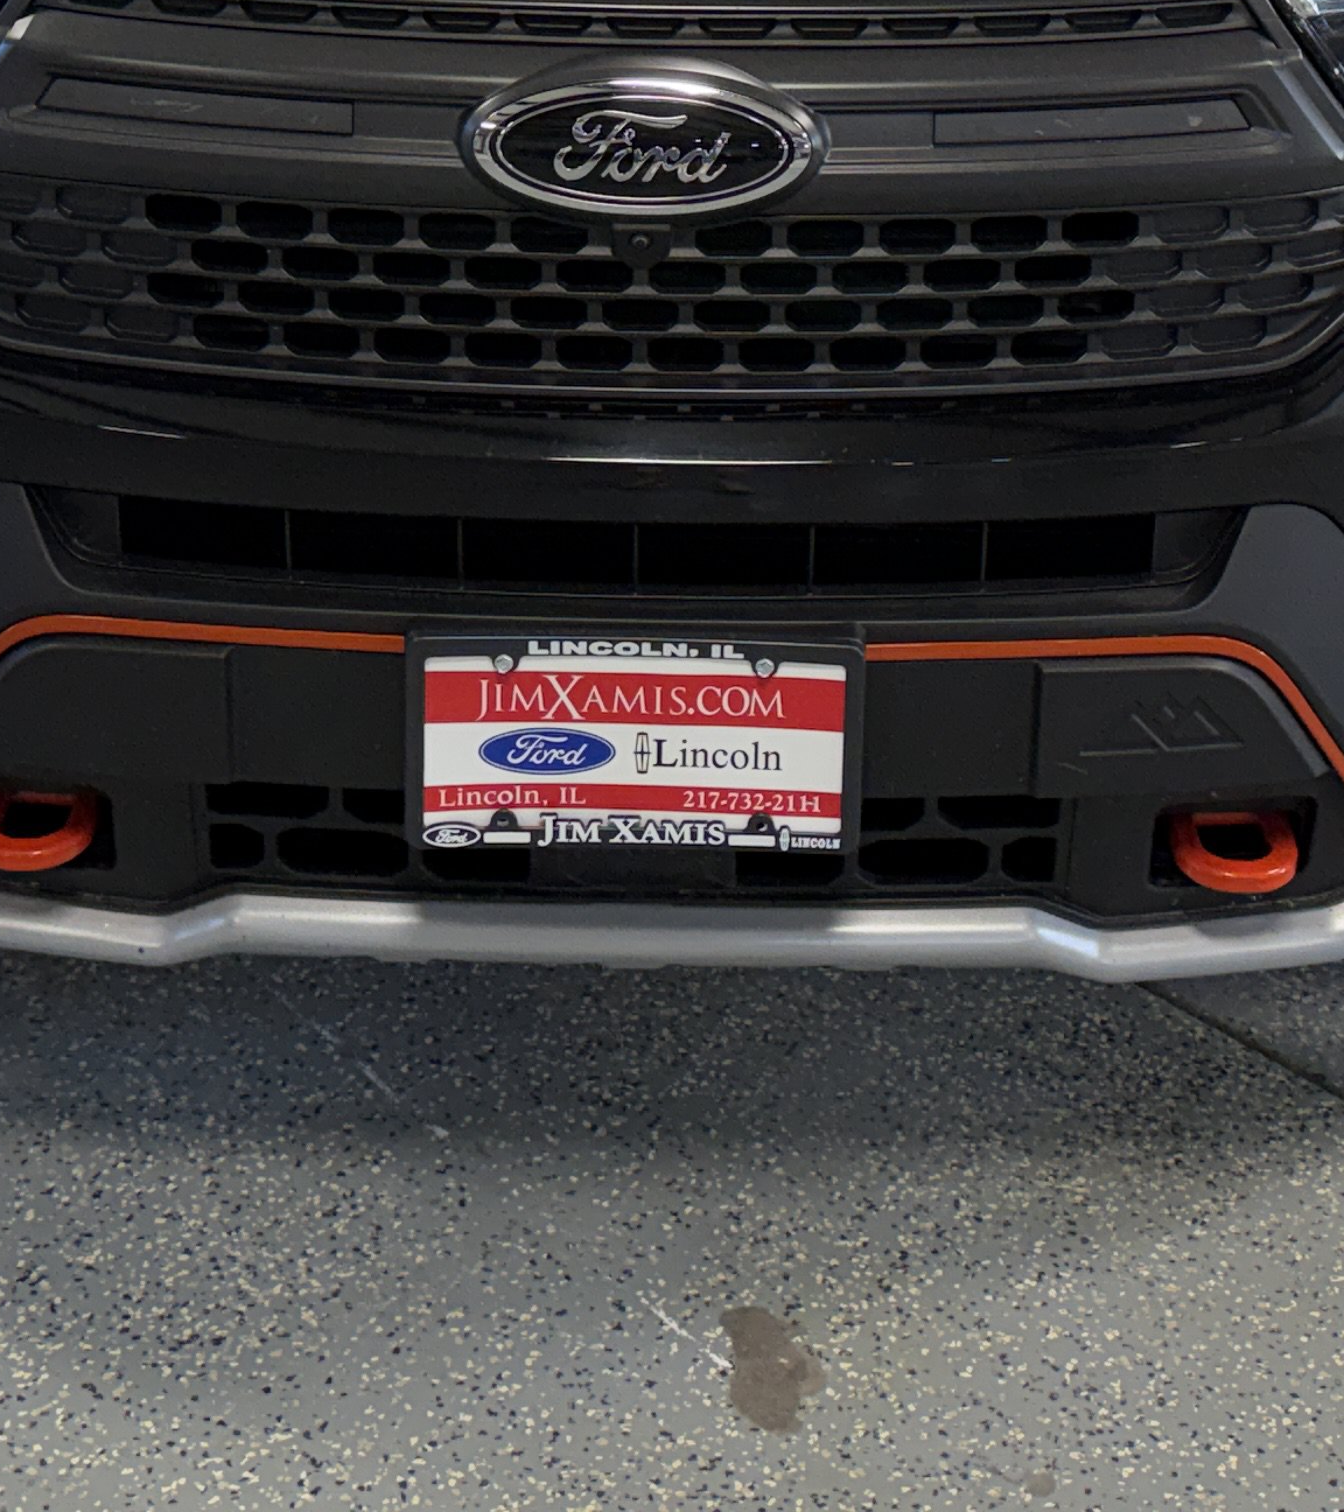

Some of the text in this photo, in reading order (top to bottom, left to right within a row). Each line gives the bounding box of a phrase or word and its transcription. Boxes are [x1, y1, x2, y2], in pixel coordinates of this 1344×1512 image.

[553, 109, 732, 184] Ford
[528, 640, 745, 660] LINCOLN, IL
[506, 733, 783, 771] Ford Lincoln
[439, 785, 549, 808] Lincoln,
[559, 786, 586, 805] IL
[434, 815, 841, 849] Ford JIM XAMIS LINCOLN
